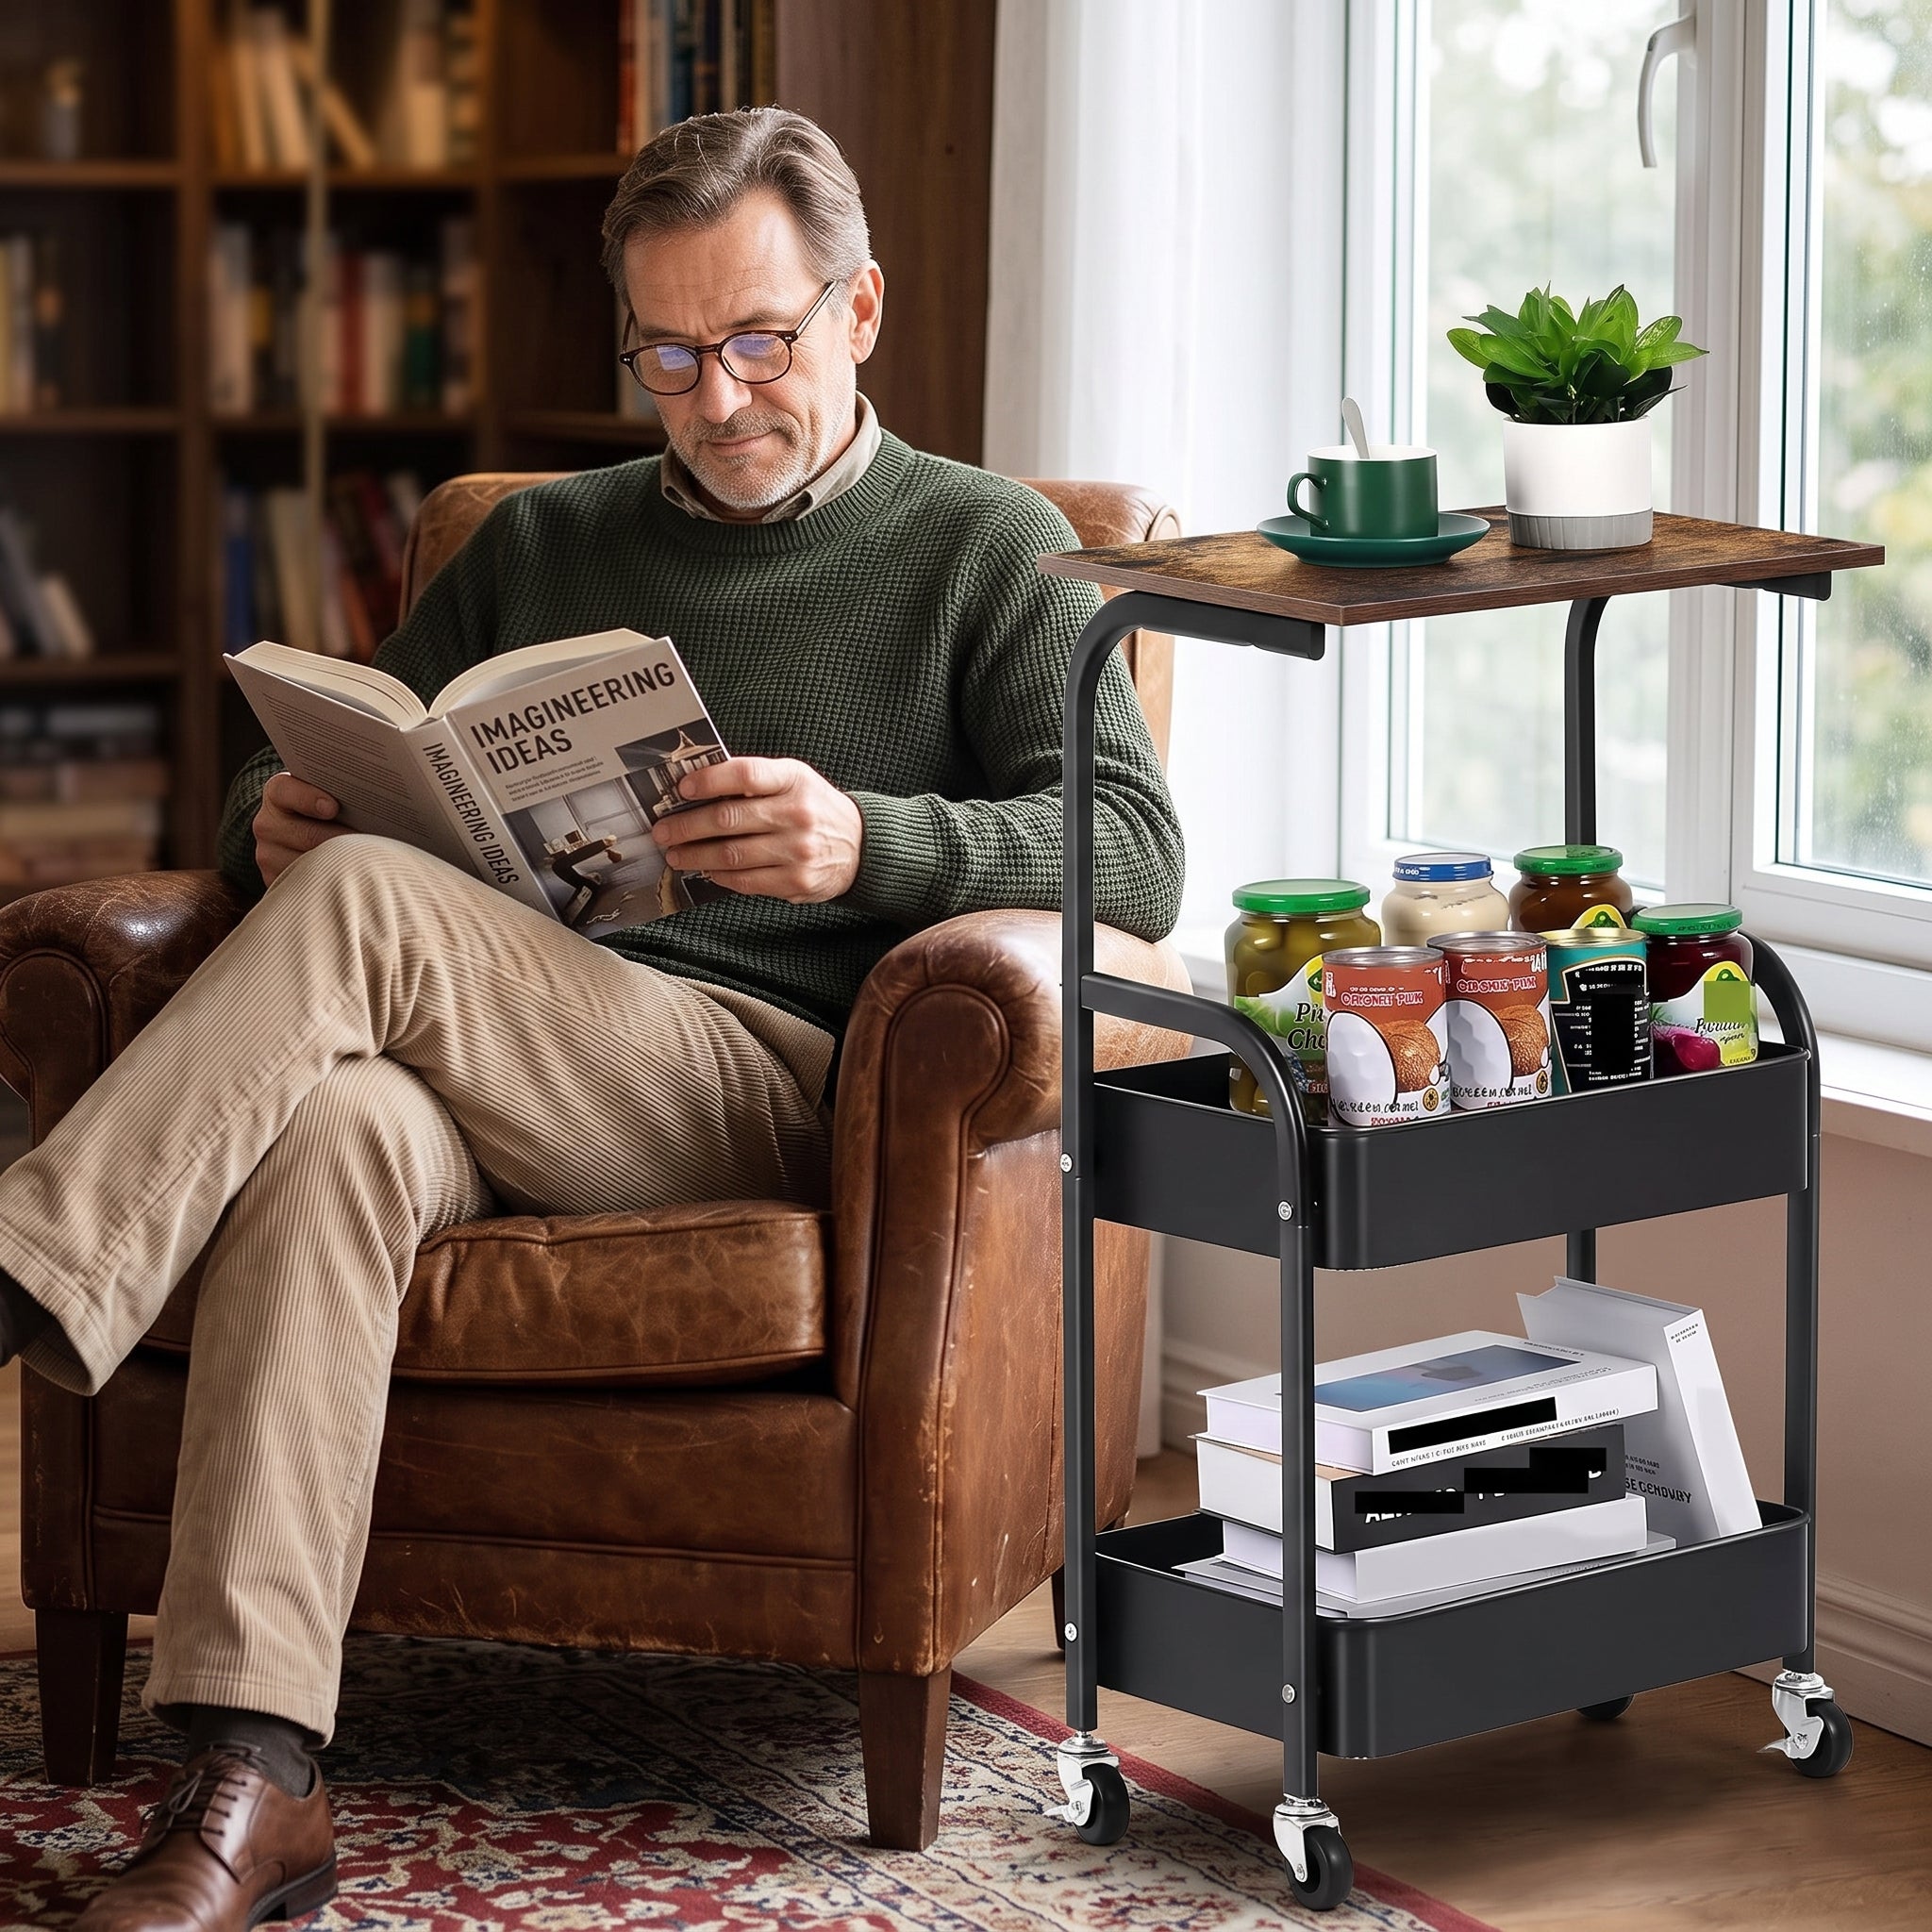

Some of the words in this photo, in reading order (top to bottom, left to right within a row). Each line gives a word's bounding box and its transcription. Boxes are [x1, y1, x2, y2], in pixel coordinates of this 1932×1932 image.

[470, 662, 675, 749] IMAGINEERING
[486, 728, 573, 774] IDEAS
[422, 741, 495, 843] IMAGINEERING
[479, 843, 520, 885] IDEAS
